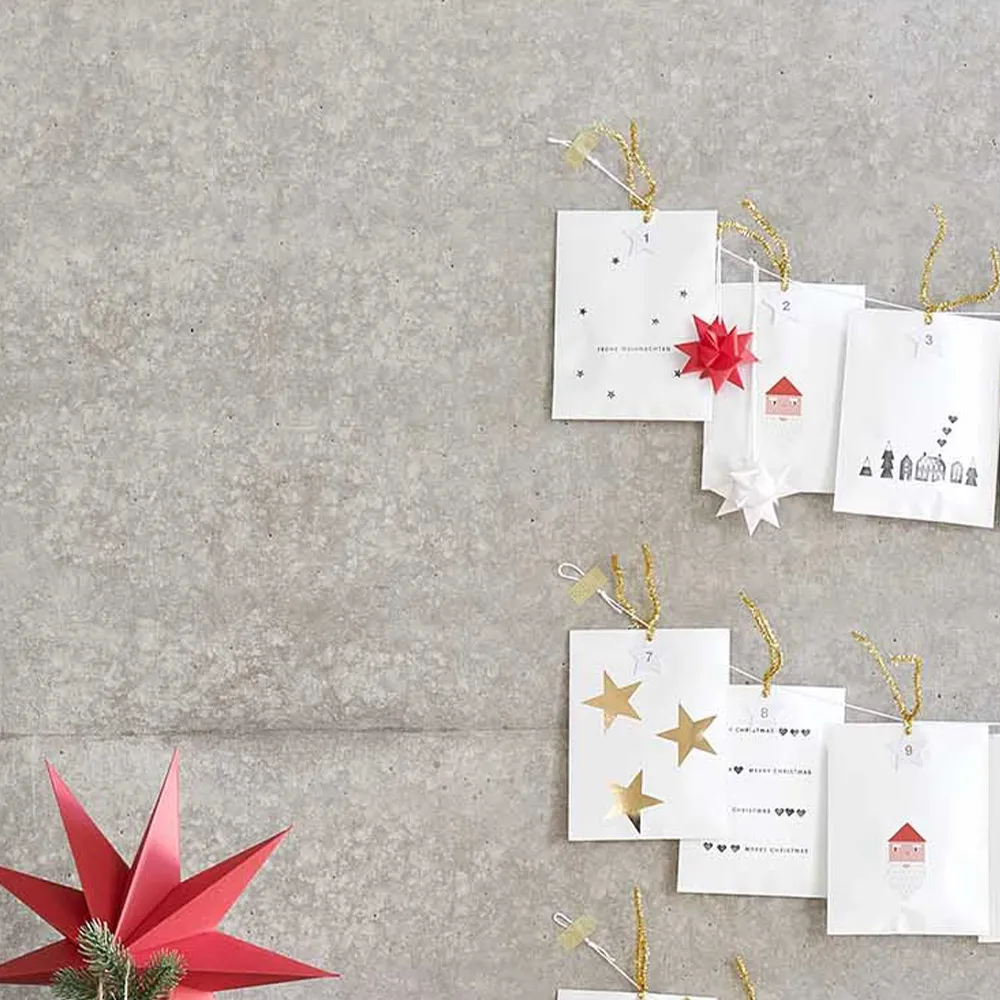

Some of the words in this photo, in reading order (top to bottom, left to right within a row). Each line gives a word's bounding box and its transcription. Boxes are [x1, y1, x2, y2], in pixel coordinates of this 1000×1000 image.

[643, 233, 650, 244] 1
[781, 300, 791, 312] 2
[924, 333, 934, 346] 3
[644, 651, 654, 663] 7
[759, 707, 769, 719] 8
[903, 744, 914, 757] 9
